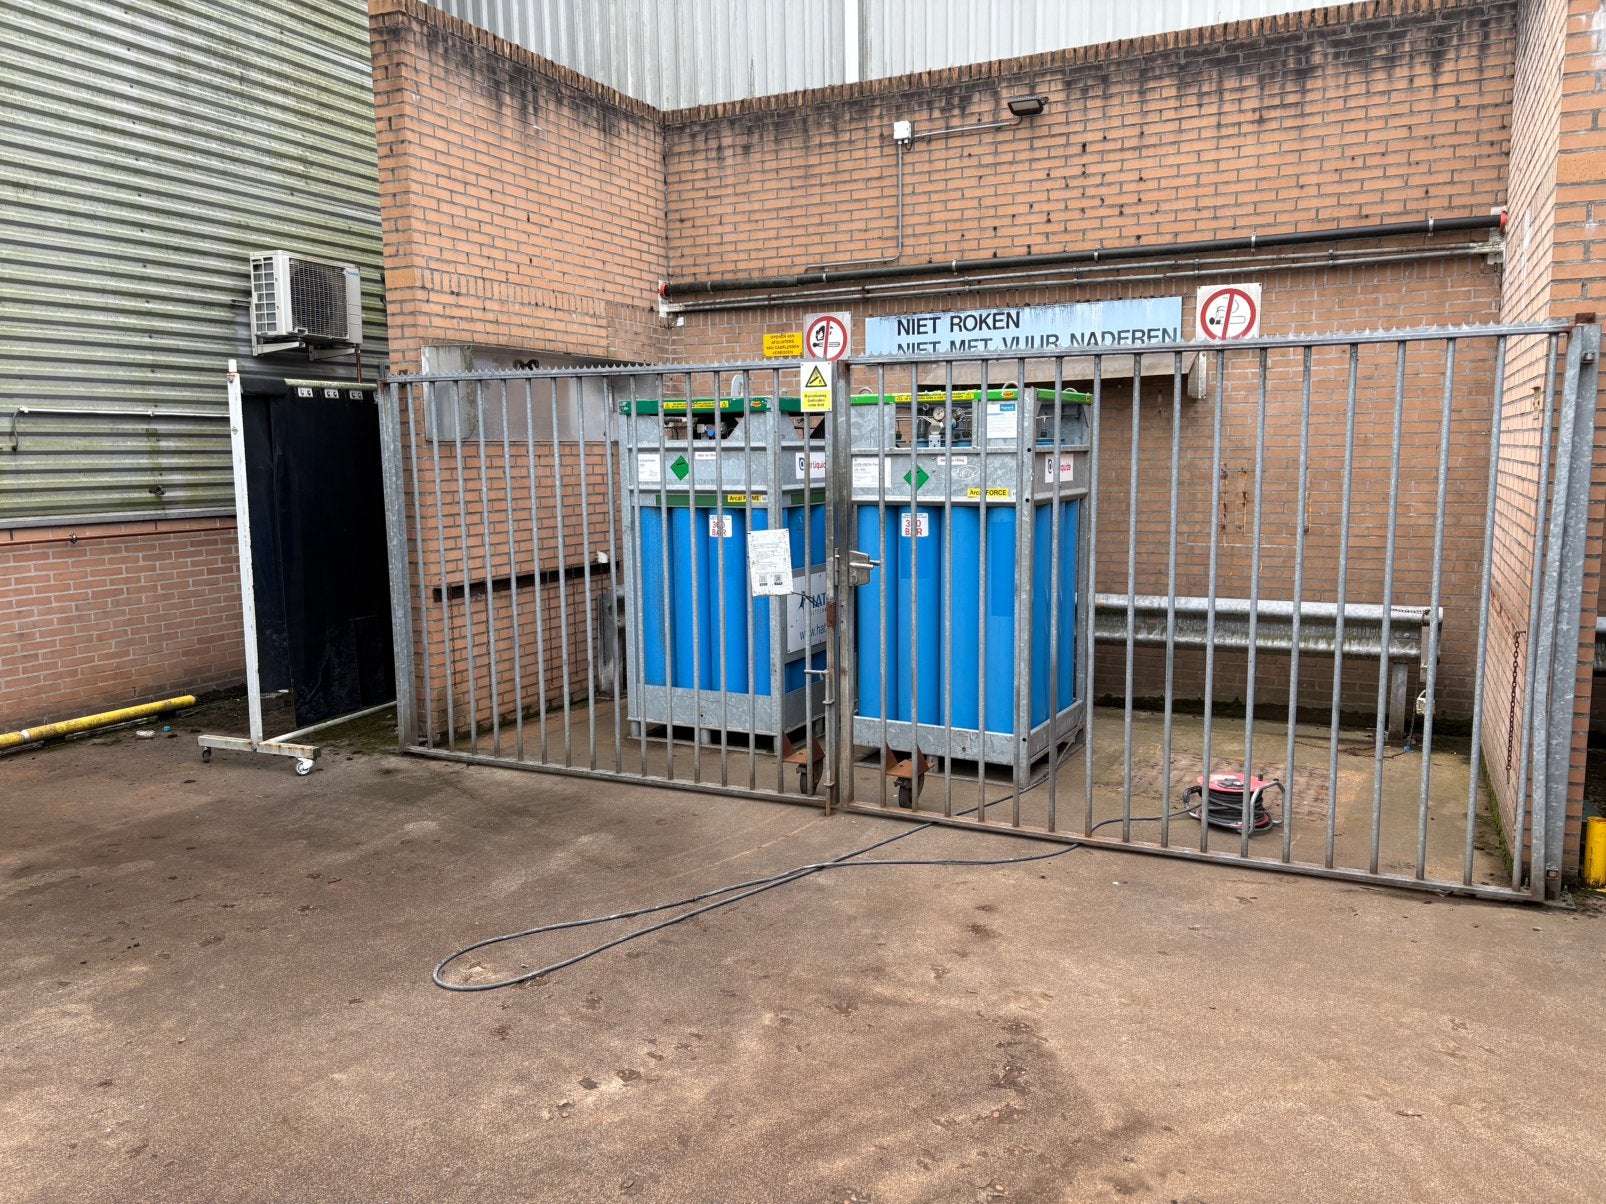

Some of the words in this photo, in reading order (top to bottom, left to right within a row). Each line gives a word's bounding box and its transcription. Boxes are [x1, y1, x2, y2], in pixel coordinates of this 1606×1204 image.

[897, 316, 942, 336] NIET
[950, 311, 1020, 333] ROKEN
[905, 519, 921, 527] 30
[905, 527, 923, 536] BR
